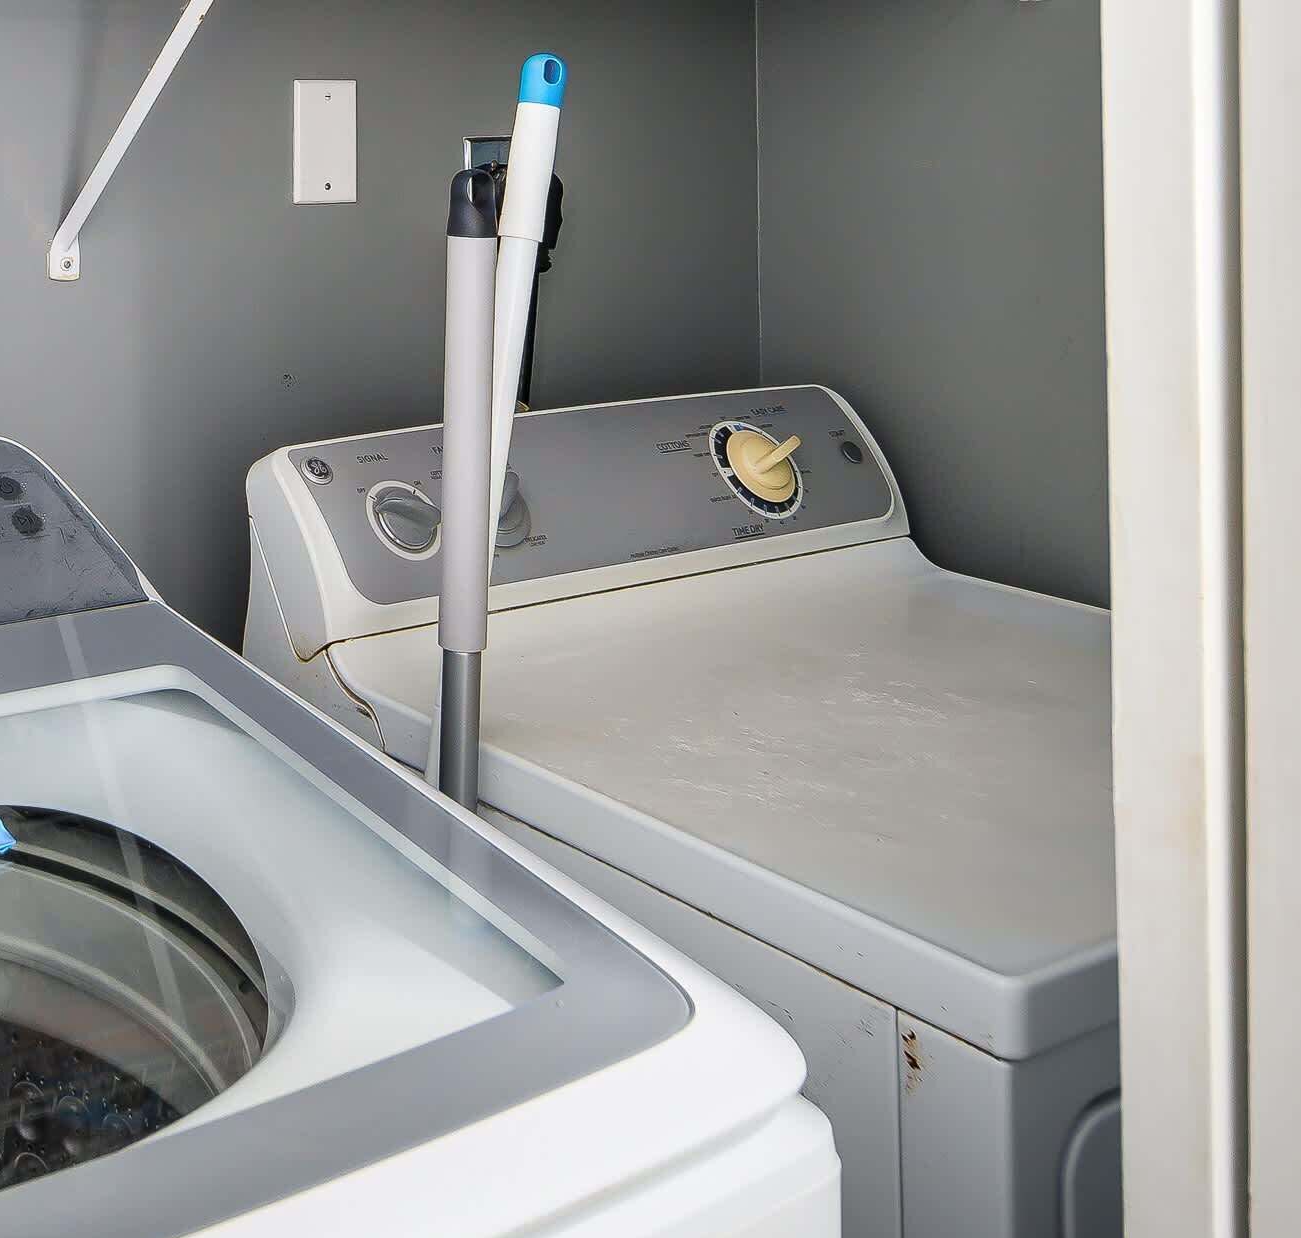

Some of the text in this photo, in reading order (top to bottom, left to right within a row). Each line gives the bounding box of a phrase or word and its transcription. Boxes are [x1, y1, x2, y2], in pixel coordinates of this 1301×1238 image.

[656, 440, 690, 451] COTTONS
[356, 453, 388, 464] SIGNAL
[732, 523, 764, 537] TIME DRY
